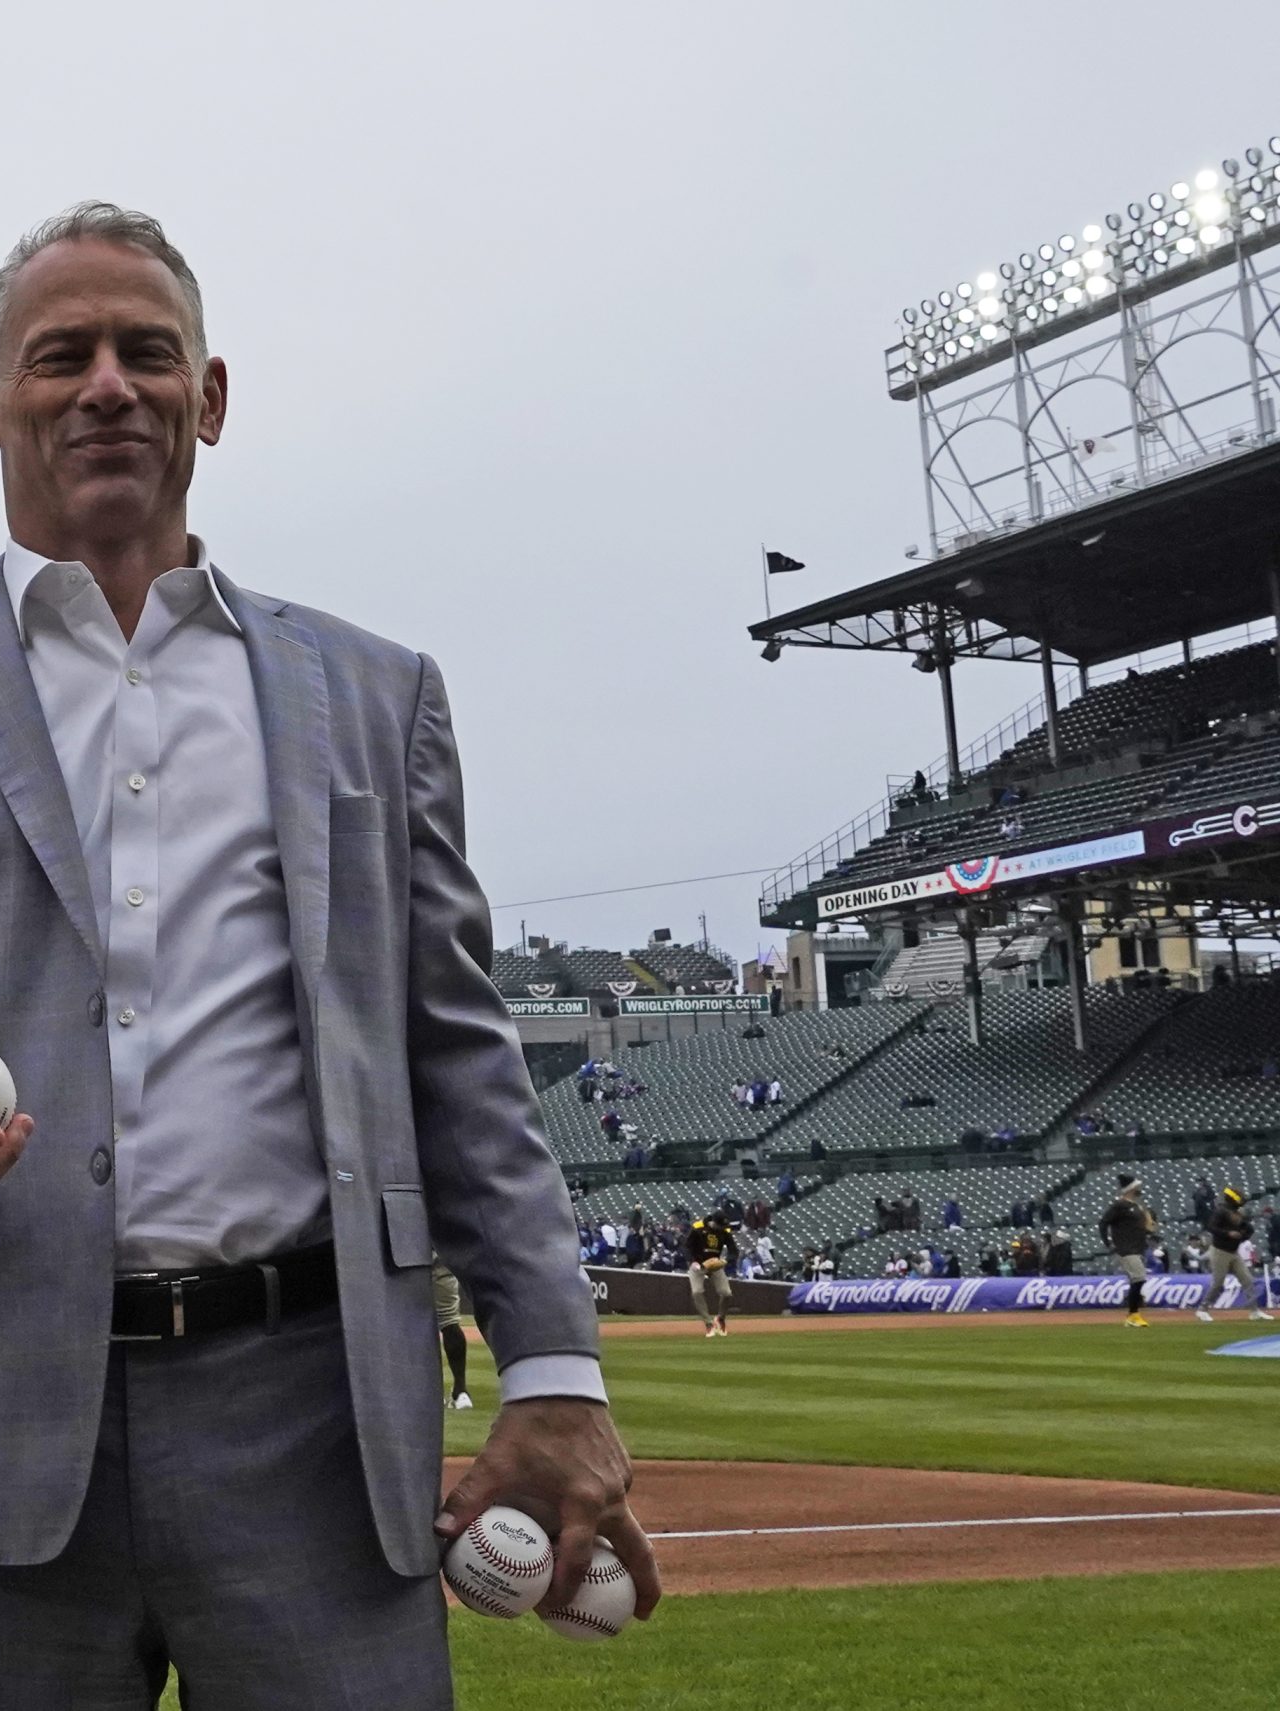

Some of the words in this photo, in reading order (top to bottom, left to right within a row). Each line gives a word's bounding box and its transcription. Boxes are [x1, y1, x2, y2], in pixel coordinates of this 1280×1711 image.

[824, 886, 888, 912] OPENING
[891, 880, 920, 899] DAY
[805, 1281, 894, 1310] Reynolds
[893, 1279, 952, 1311] Wrap
[1016, 1278, 1130, 1310] Reynolds
[493, 1521, 536, 1544] Rawlings
